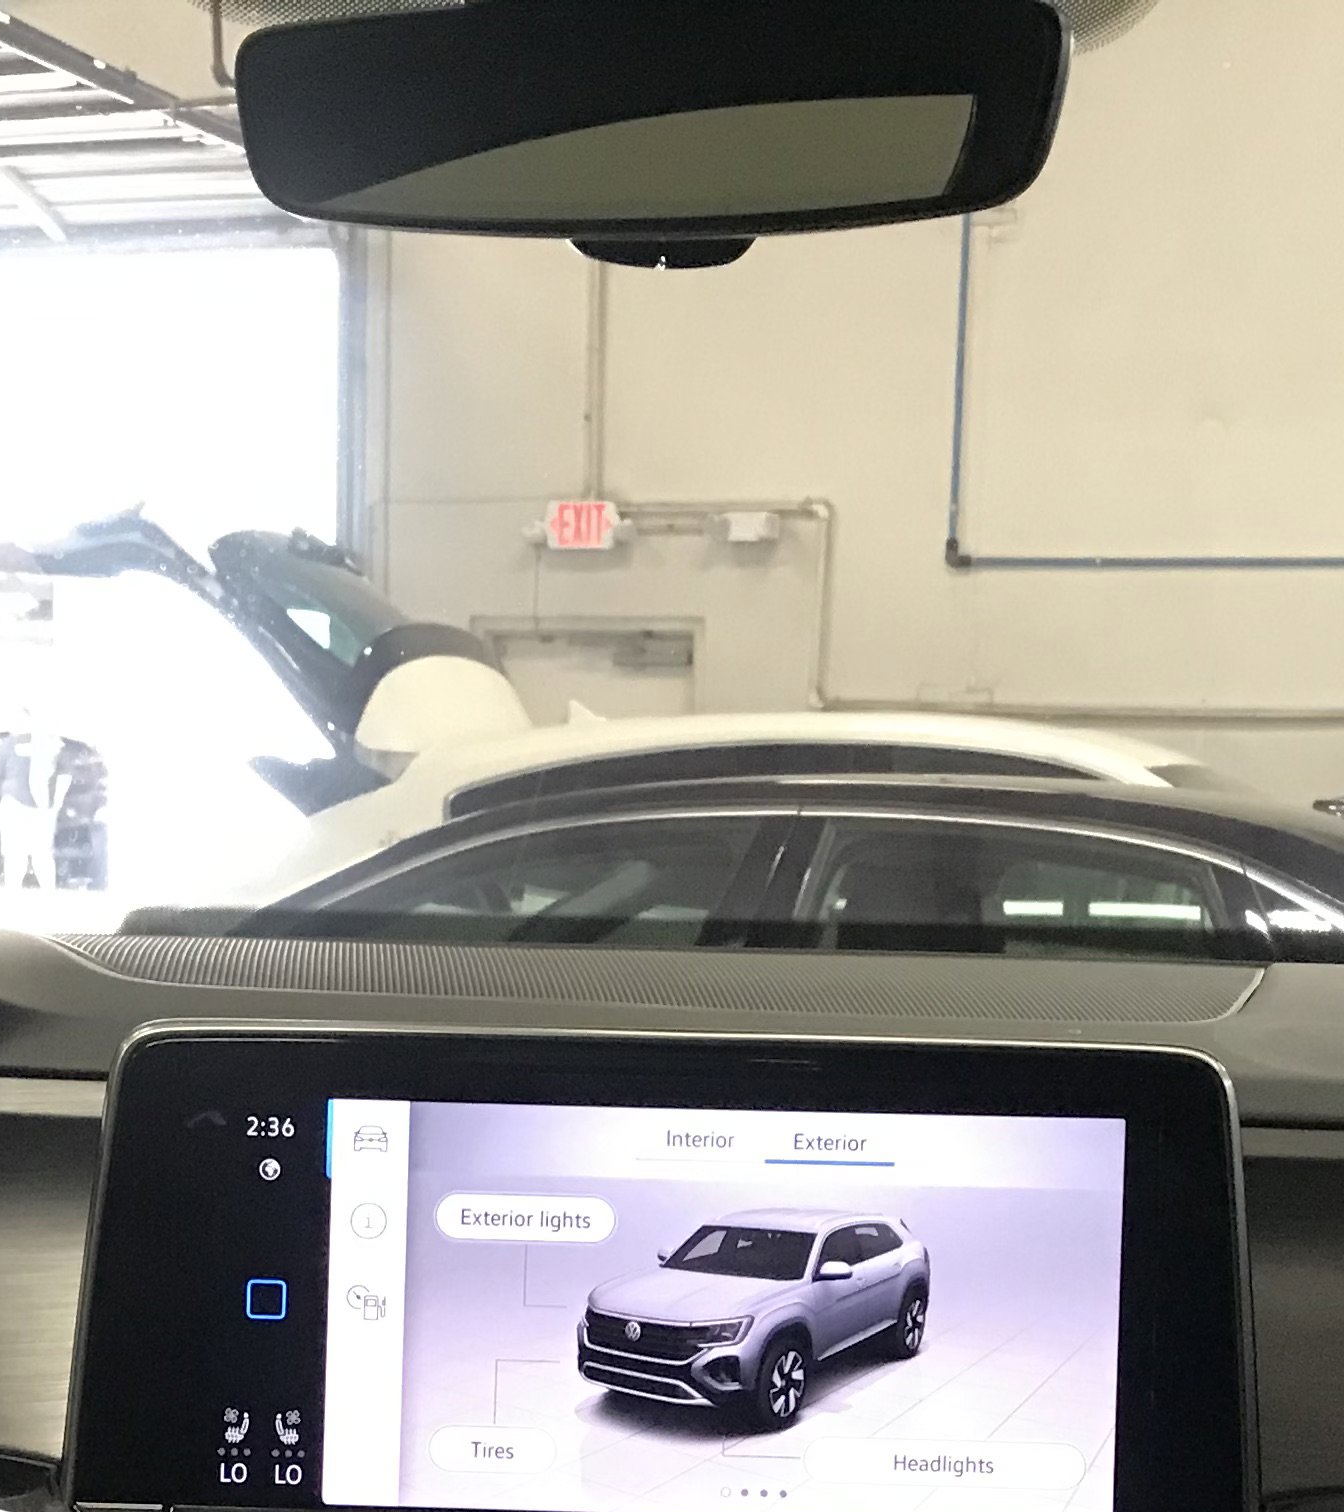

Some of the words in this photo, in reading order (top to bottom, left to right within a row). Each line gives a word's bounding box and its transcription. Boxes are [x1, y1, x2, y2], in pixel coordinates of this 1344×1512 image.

[559, 503, 605, 546] EXIT
[246, 1116, 295, 1138] 2:36
[666, 1130, 736, 1149] Interior
[793, 1133, 868, 1152] Exterior
[460, 1209, 533, 1228] Exterior
[539, 1211, 591, 1232] lights
[470, 1440, 514, 1460] Tires
[219, 1462, 248, 1484] LO
[274, 1464, 304, 1486] LO
[892, 1453, 995, 1476] Headlights
